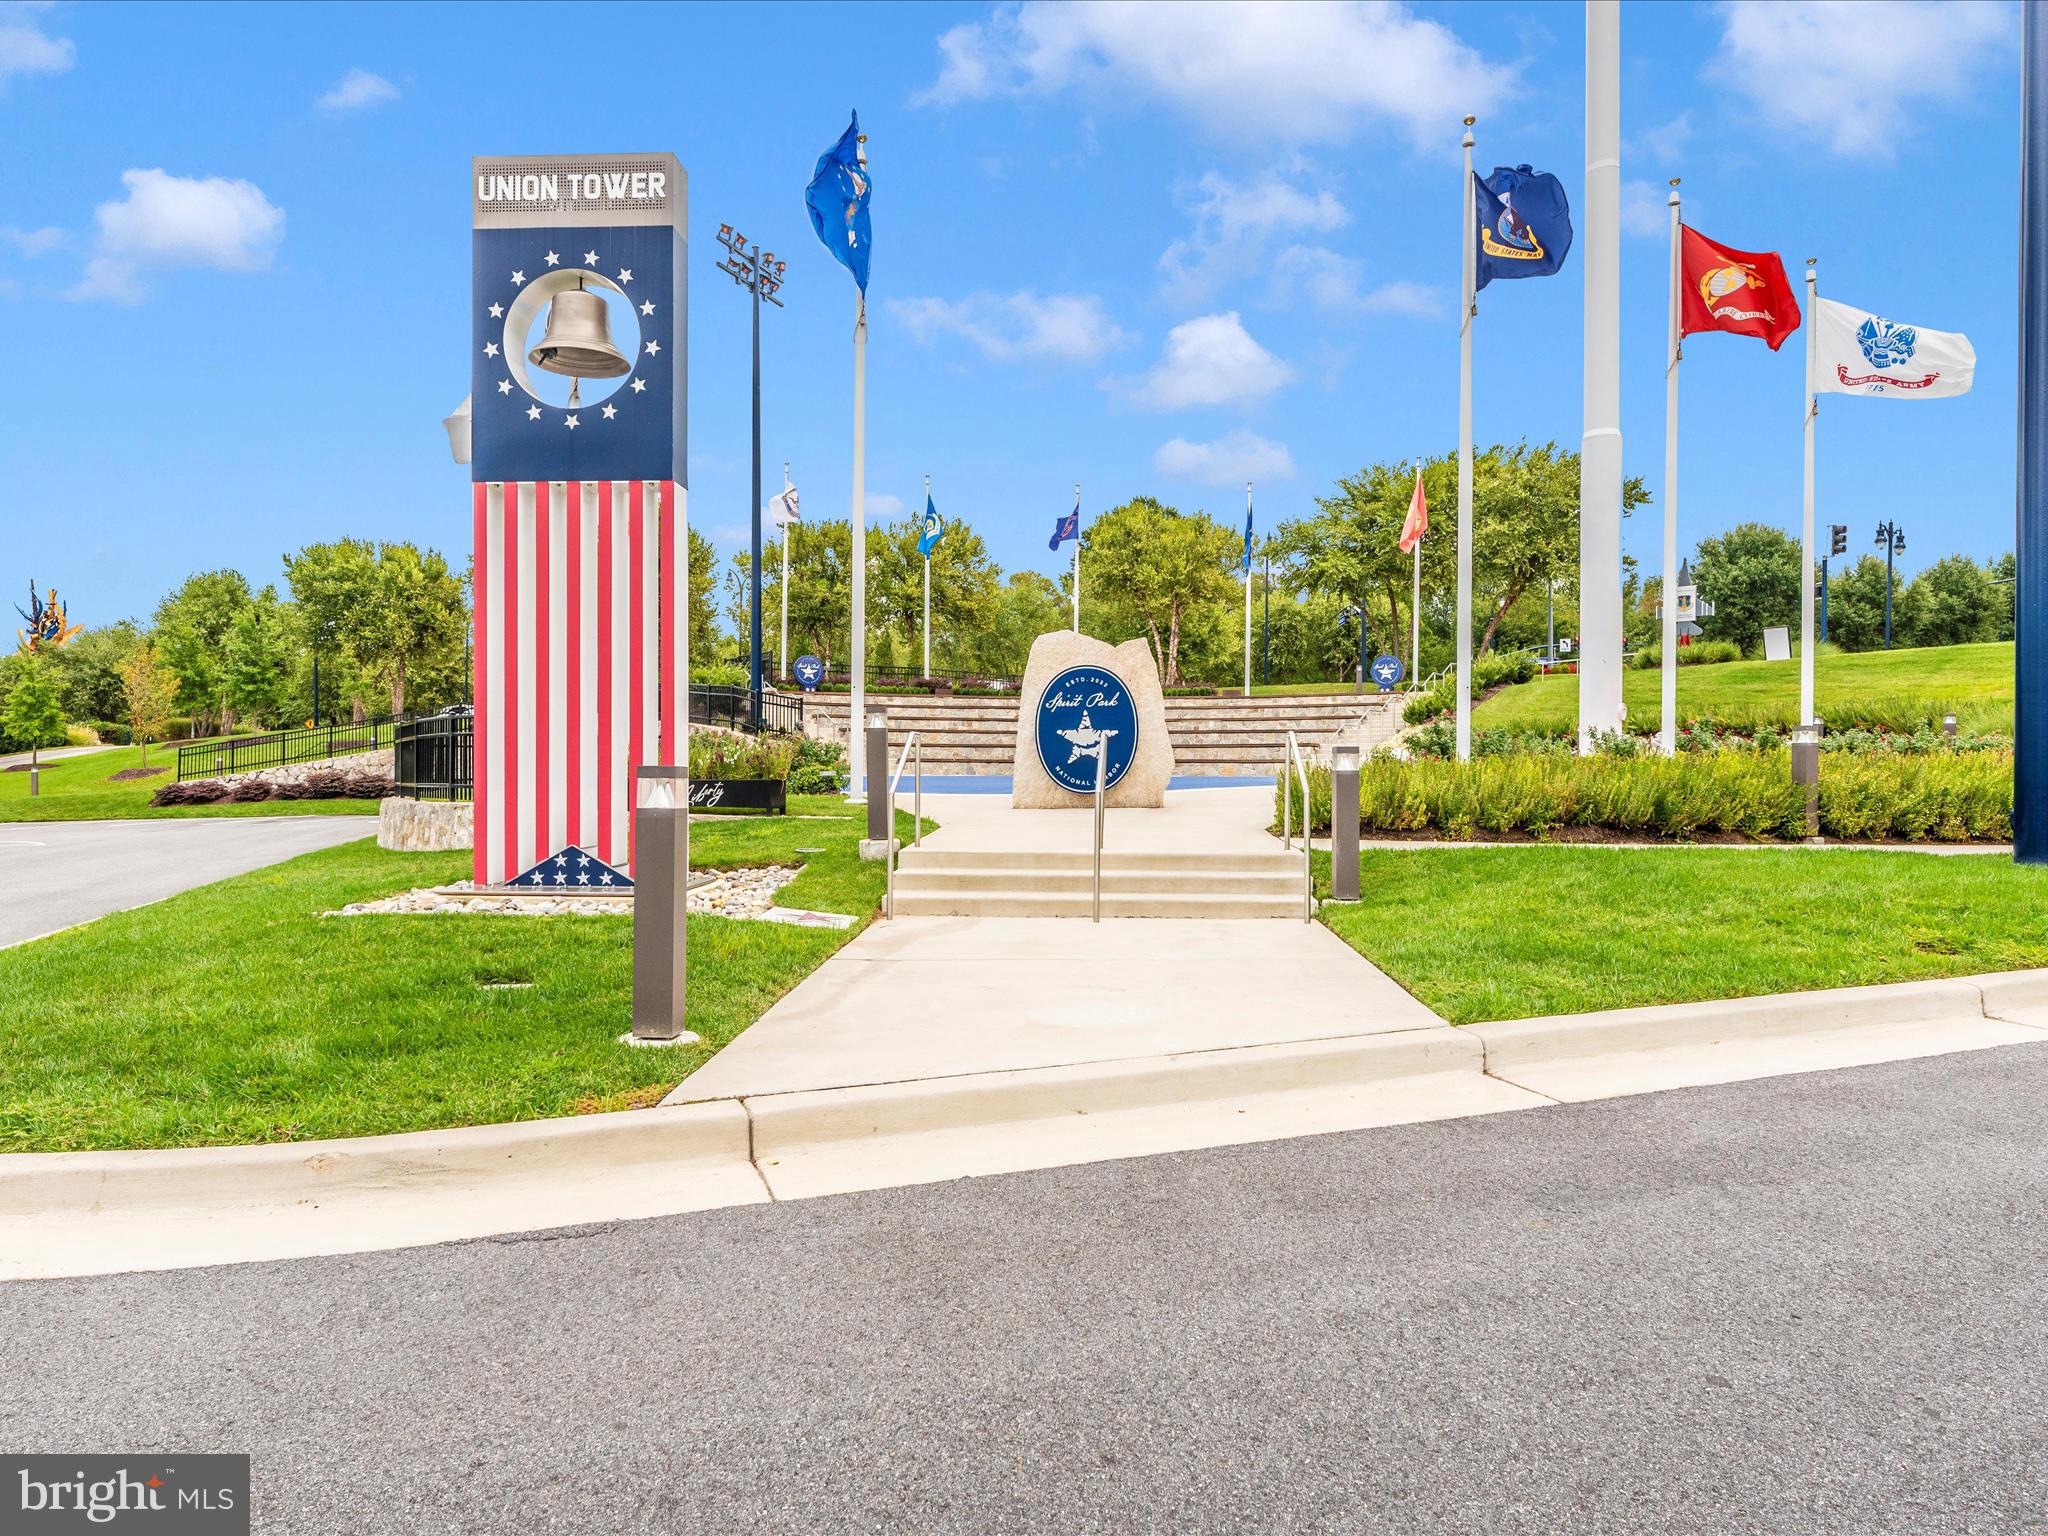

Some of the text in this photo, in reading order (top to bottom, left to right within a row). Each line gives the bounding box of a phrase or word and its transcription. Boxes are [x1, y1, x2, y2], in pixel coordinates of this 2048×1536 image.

[478, 172, 667, 201] UNION TOWER
[1896, 381, 1925, 389] ARMY
[1045, 691, 1120, 713] Spirit Park
[1055, 765, 1091, 786] NATIONAL
